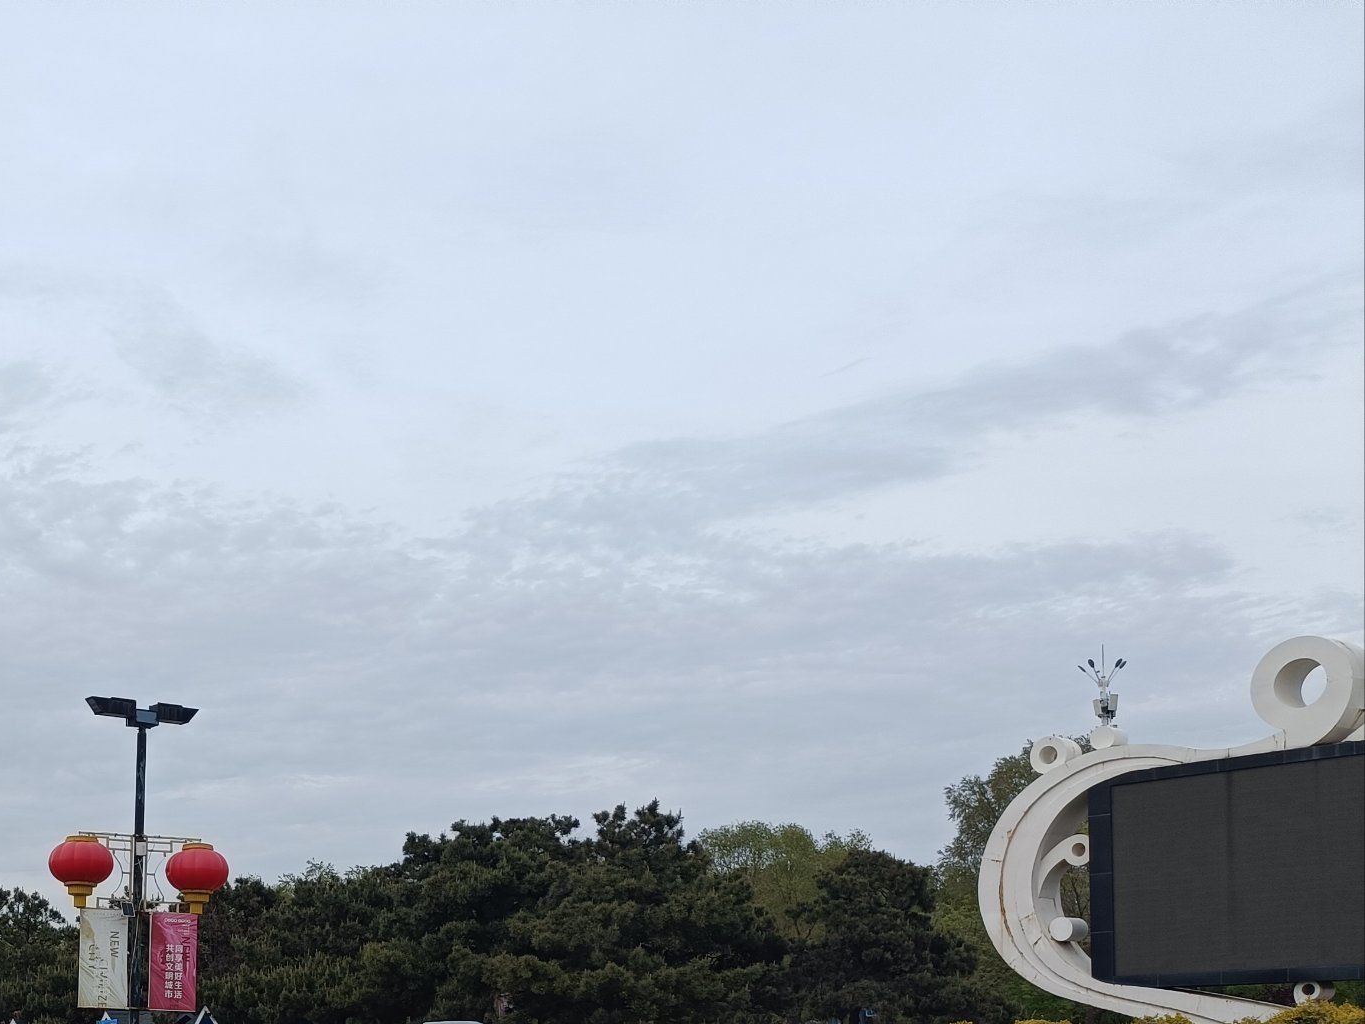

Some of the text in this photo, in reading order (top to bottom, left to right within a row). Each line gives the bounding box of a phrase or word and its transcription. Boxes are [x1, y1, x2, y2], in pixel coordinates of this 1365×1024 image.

[109, 931, 120, 958] NEW
[165, 944, 174, 999] 共创文明城市
[174, 944, 183, 999] 同享美好生活
